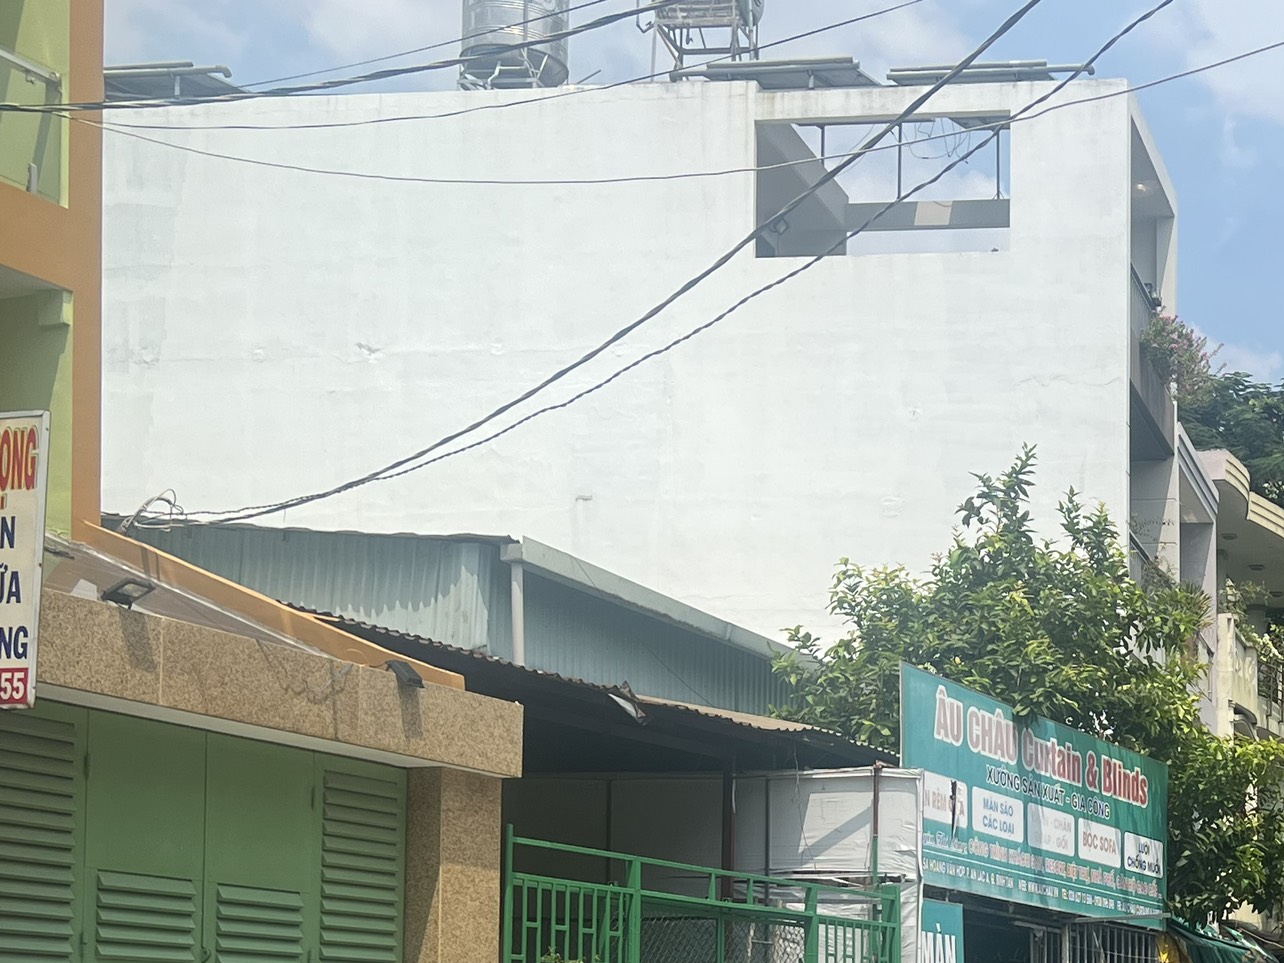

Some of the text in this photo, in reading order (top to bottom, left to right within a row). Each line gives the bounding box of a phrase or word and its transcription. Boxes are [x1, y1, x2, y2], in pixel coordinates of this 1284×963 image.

[934, 685, 1149, 808] ÂU CHÂU Curtain & Blinds
